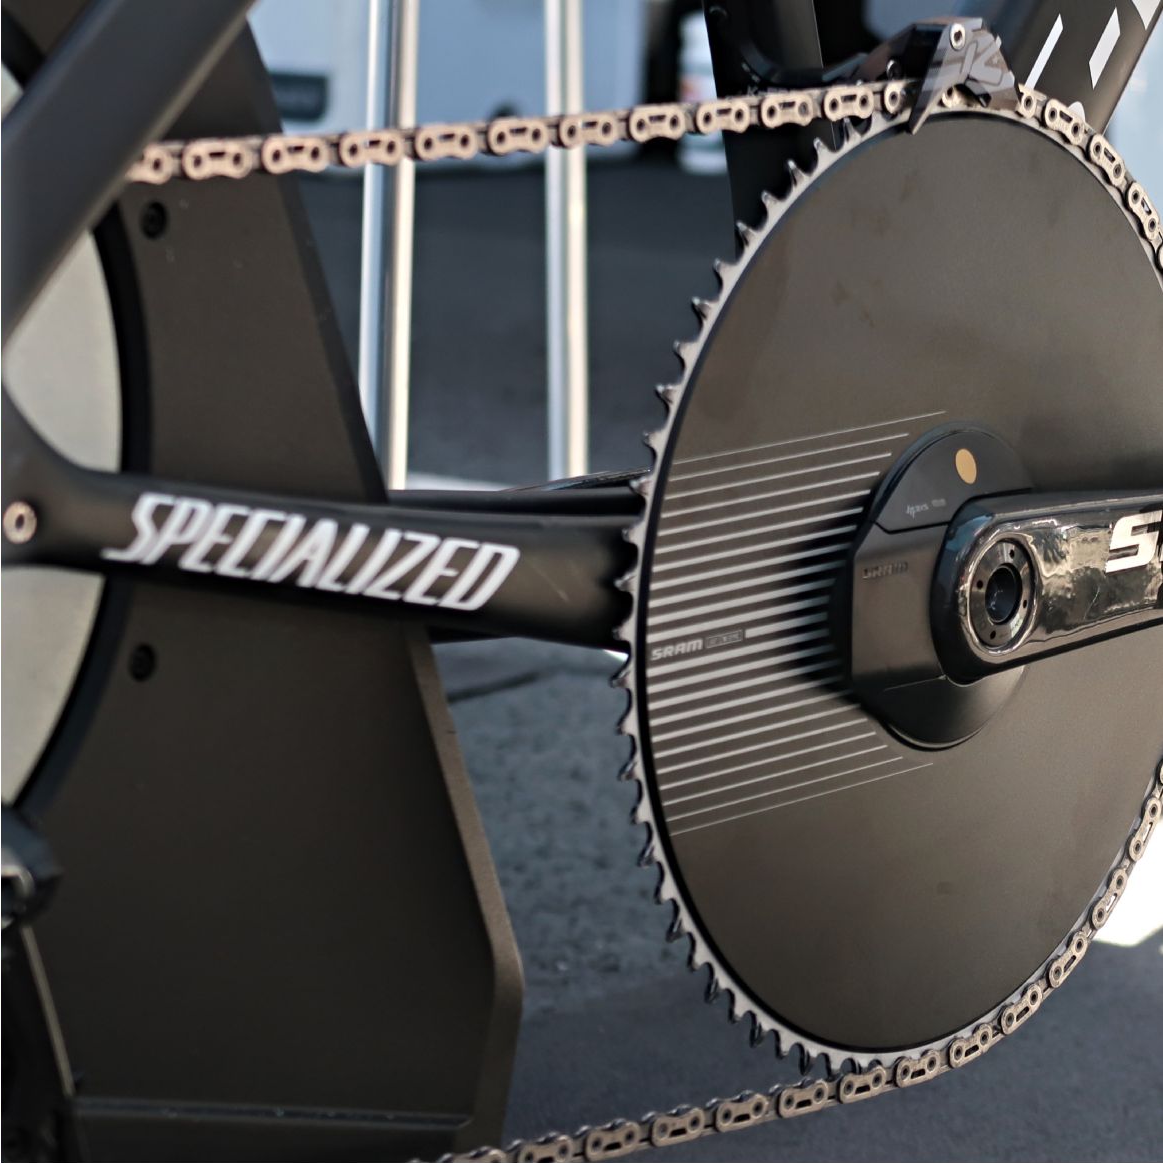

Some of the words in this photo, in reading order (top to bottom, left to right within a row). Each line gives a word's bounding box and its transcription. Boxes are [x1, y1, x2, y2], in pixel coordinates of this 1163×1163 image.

[100, 492, 521, 611] SPECIALIZED
[1105, 509, 1163, 573] S
[650, 638, 704, 661] SRAM
